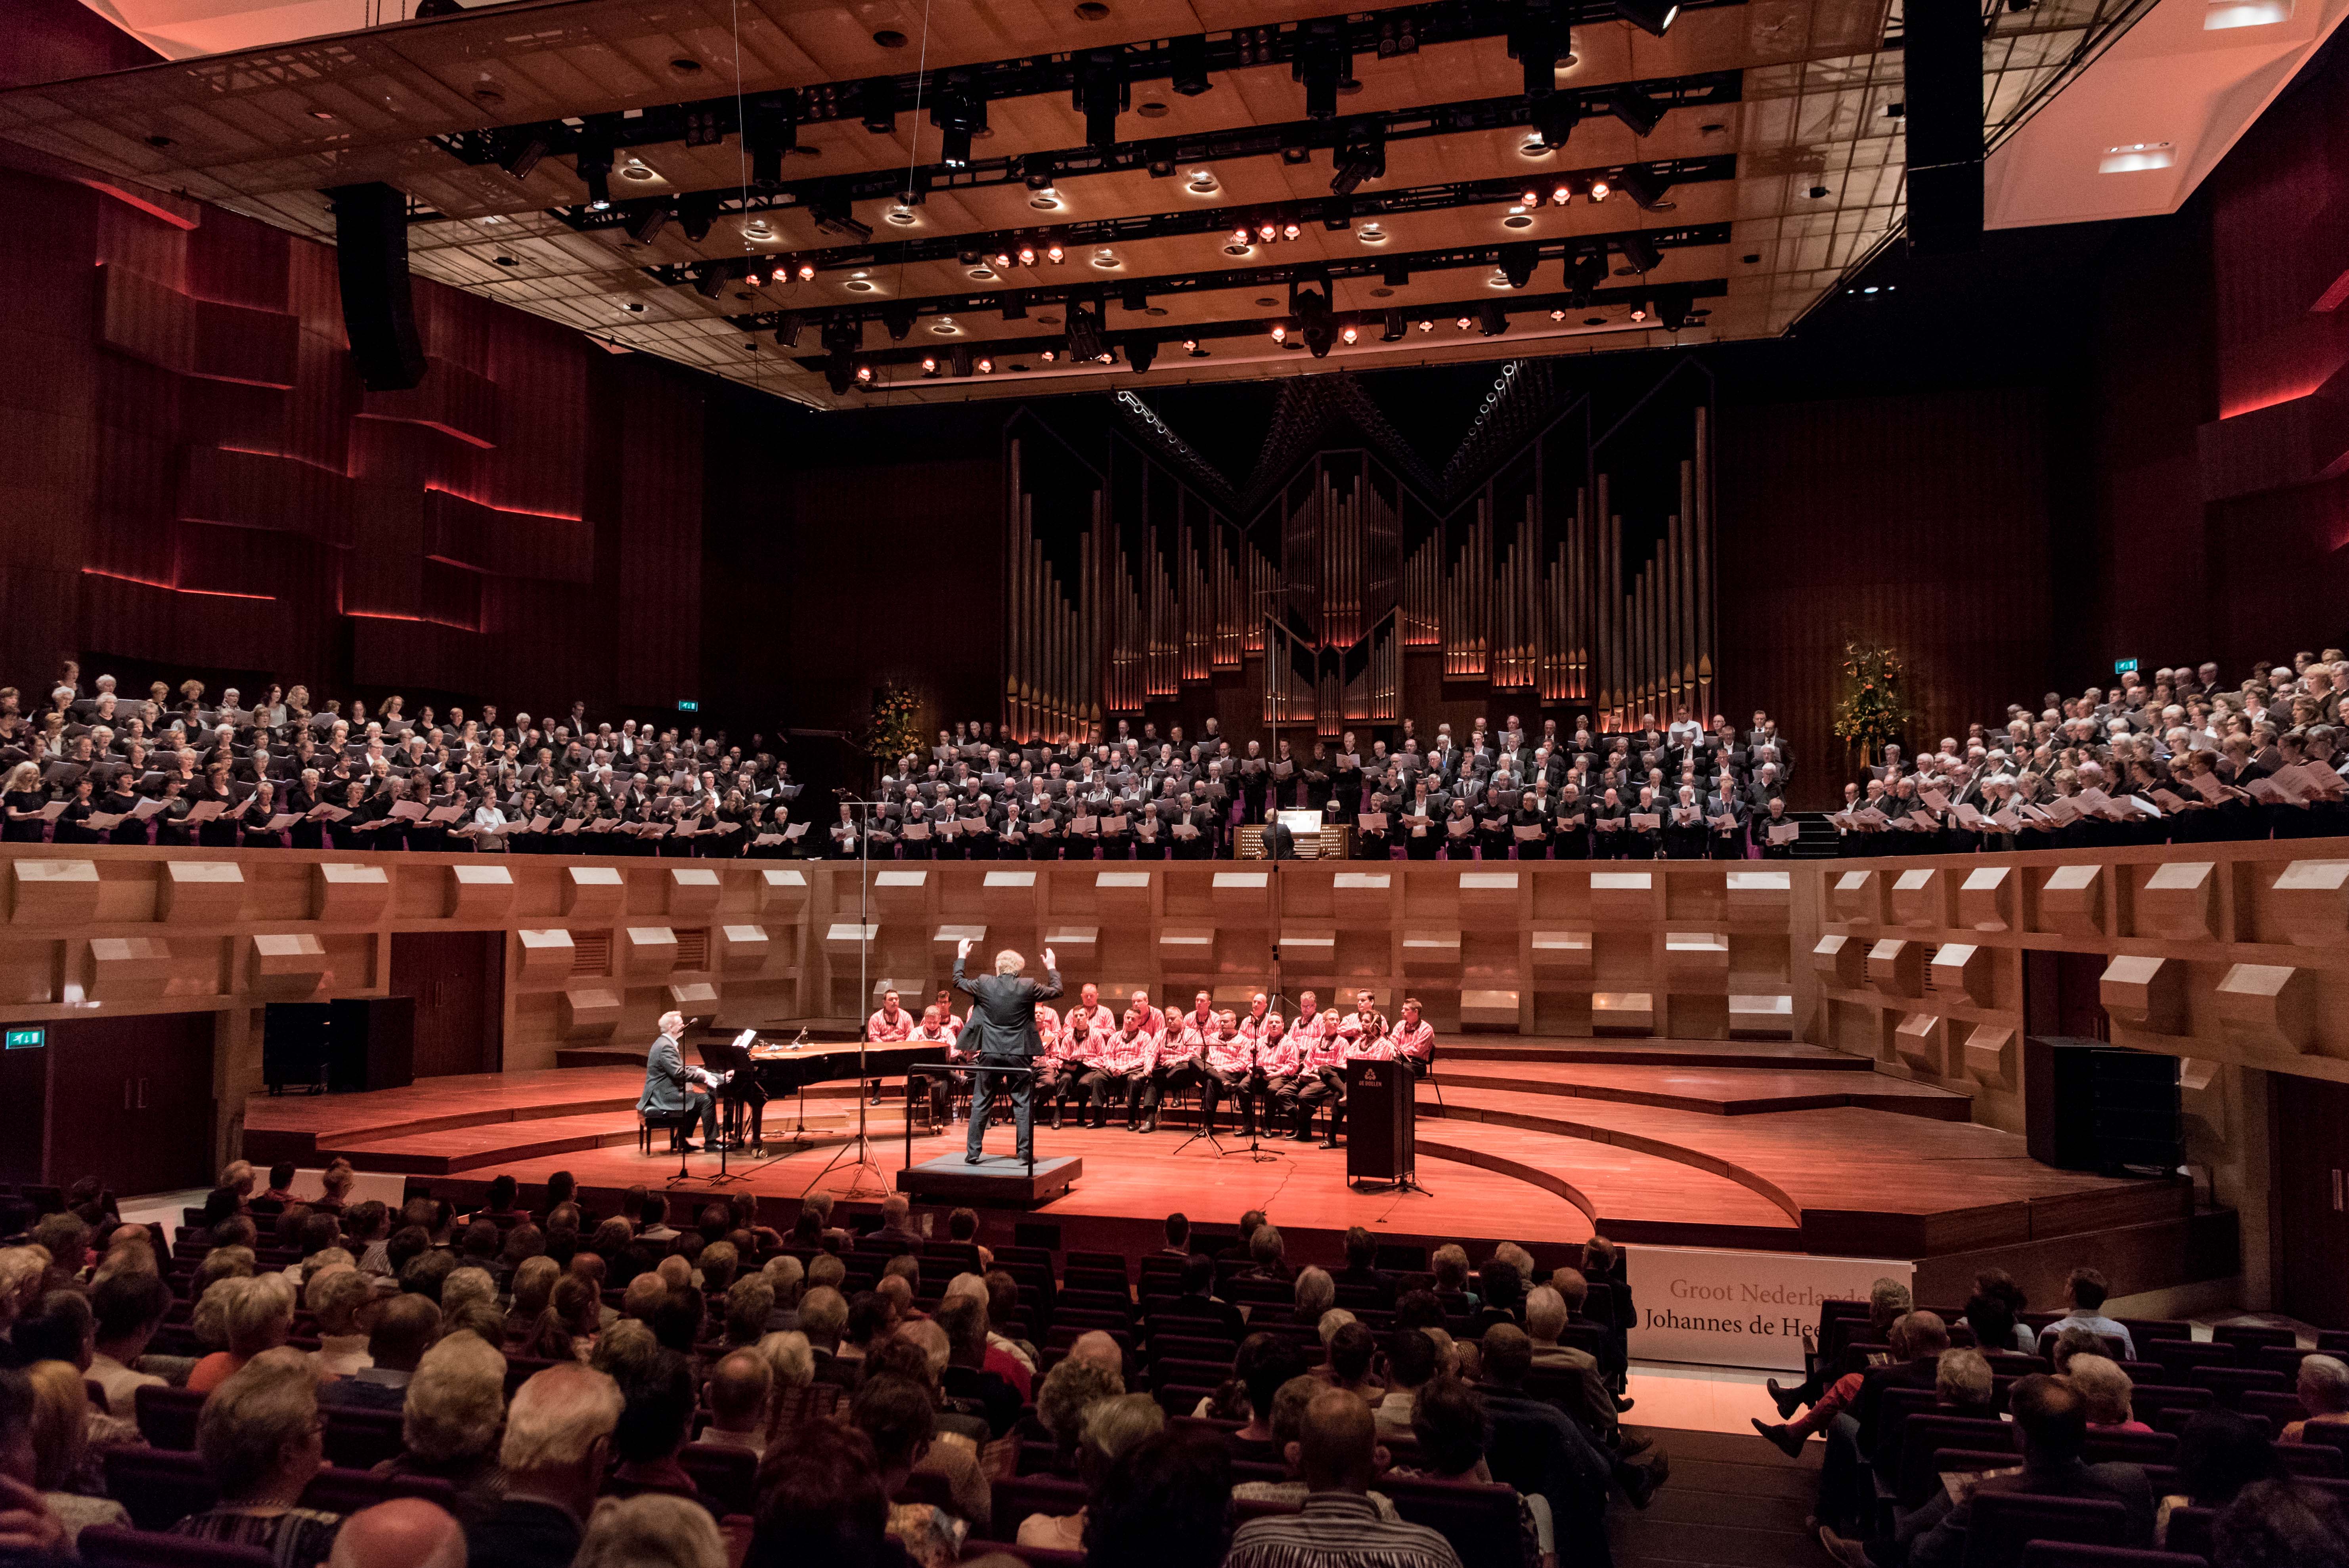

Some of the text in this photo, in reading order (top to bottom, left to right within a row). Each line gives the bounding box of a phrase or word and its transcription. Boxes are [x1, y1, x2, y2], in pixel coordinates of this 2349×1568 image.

[1670, 1279, 1734, 1300] Groot
[1645, 1309, 1742, 1333] Johannes
[1750, 1315, 1774, 1335] de
